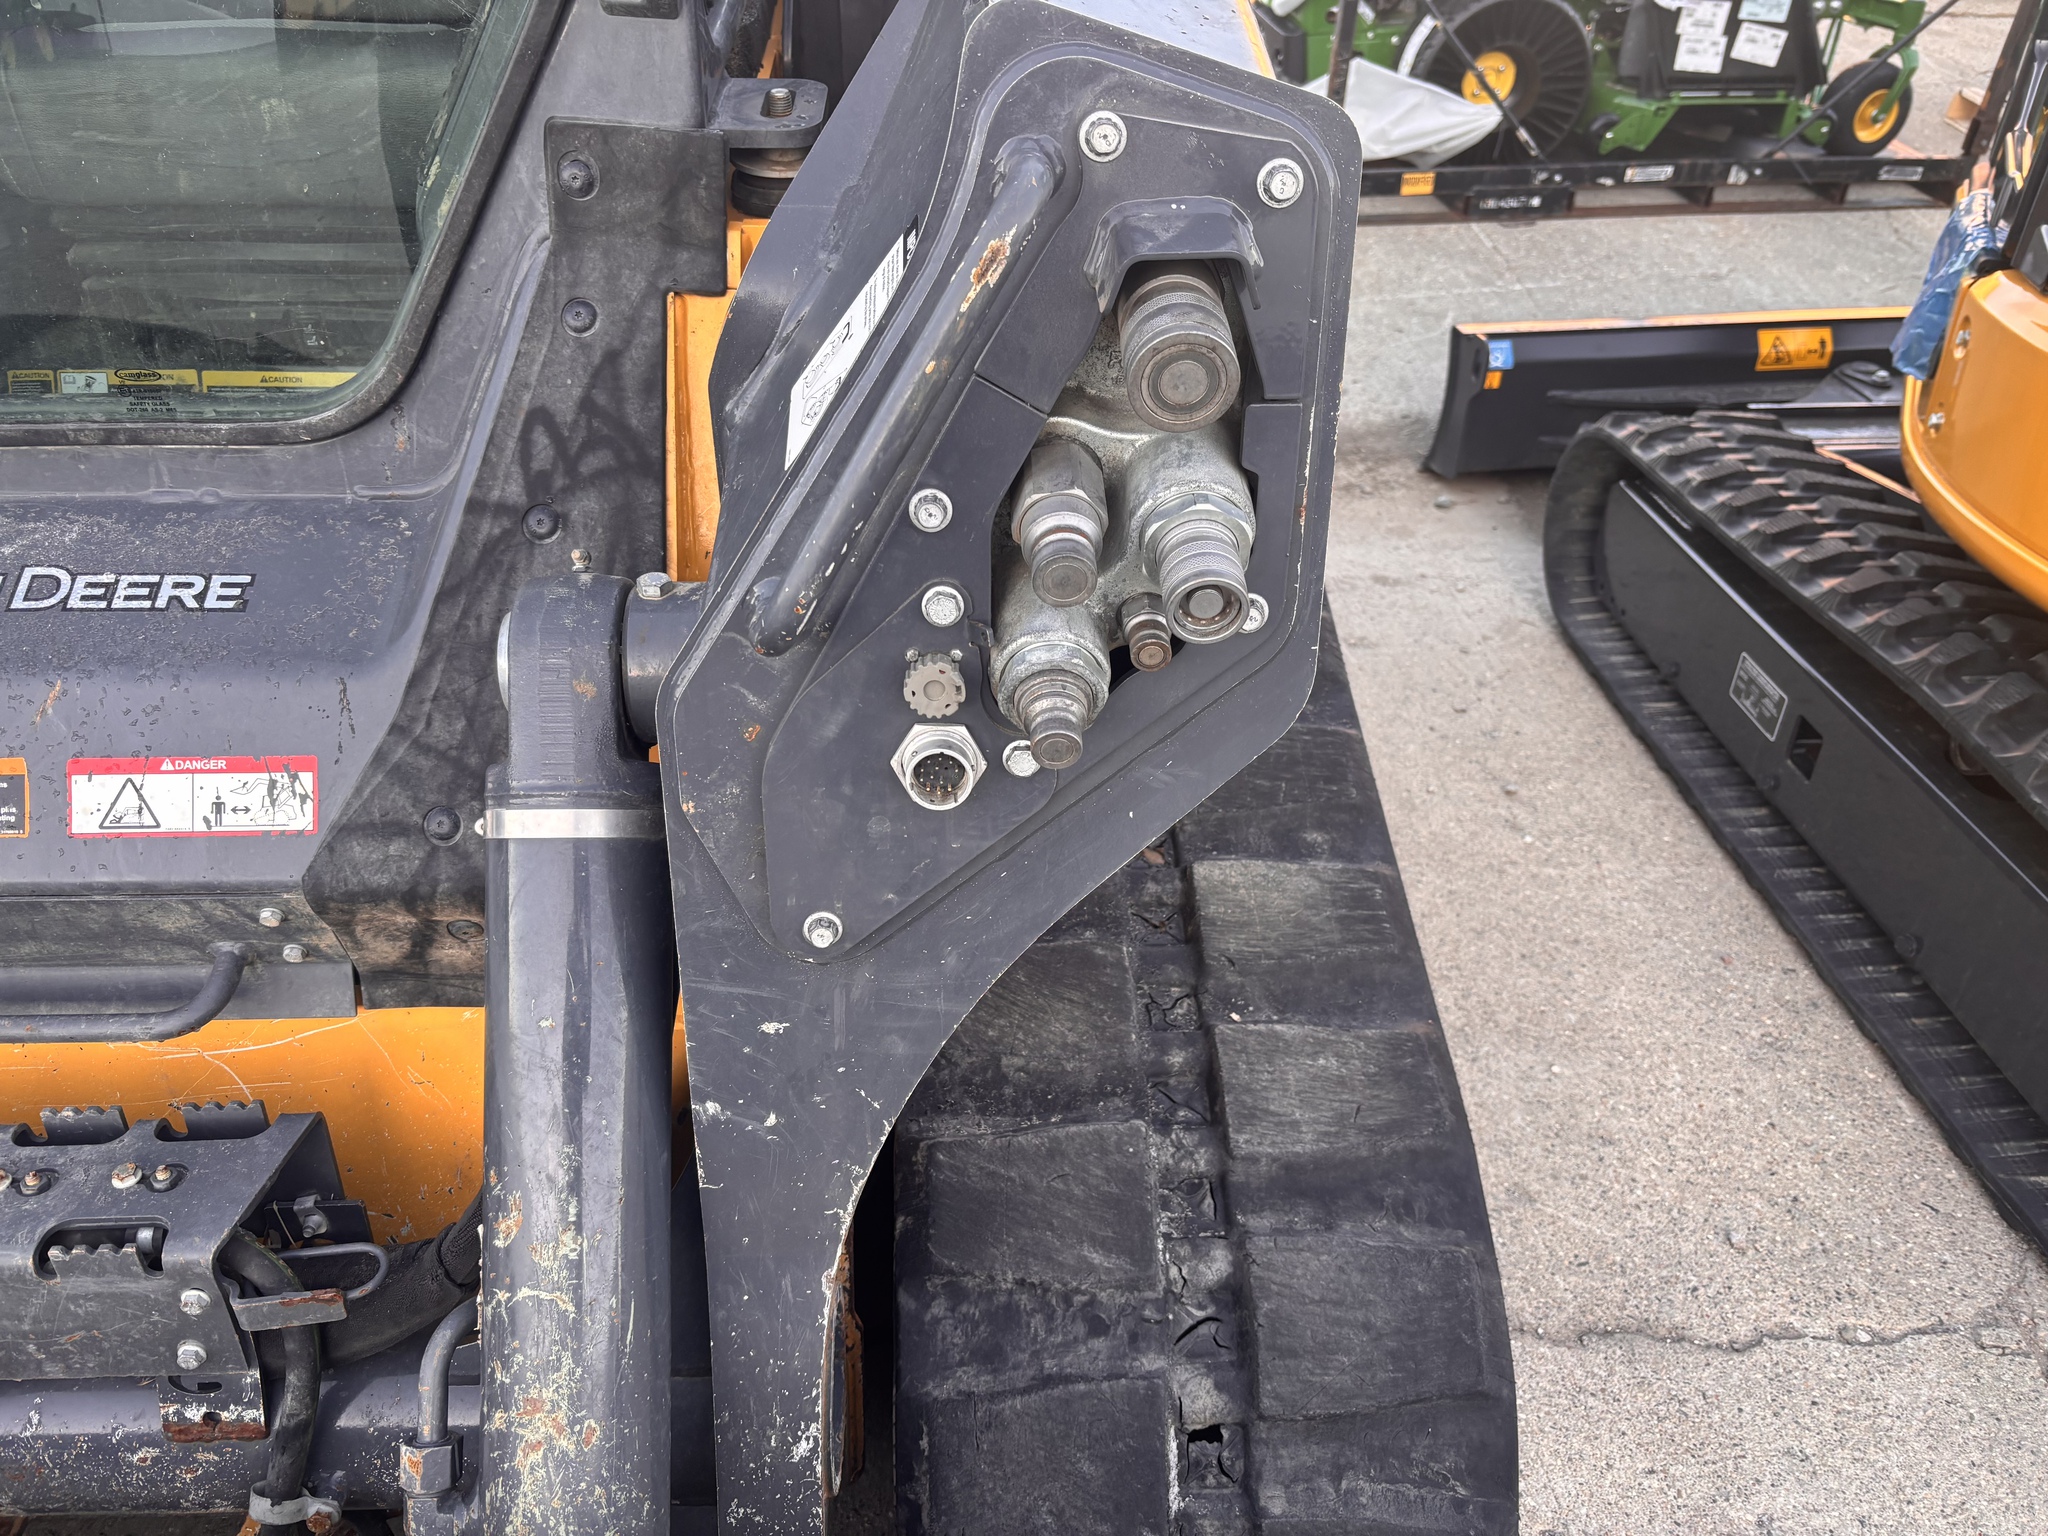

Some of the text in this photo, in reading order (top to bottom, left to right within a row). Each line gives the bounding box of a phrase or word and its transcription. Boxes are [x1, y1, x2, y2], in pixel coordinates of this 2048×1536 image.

[118, 371, 157, 379] camglass
[8, 565, 254, 611] DEERE
[175, 759, 227, 770] DANGER
